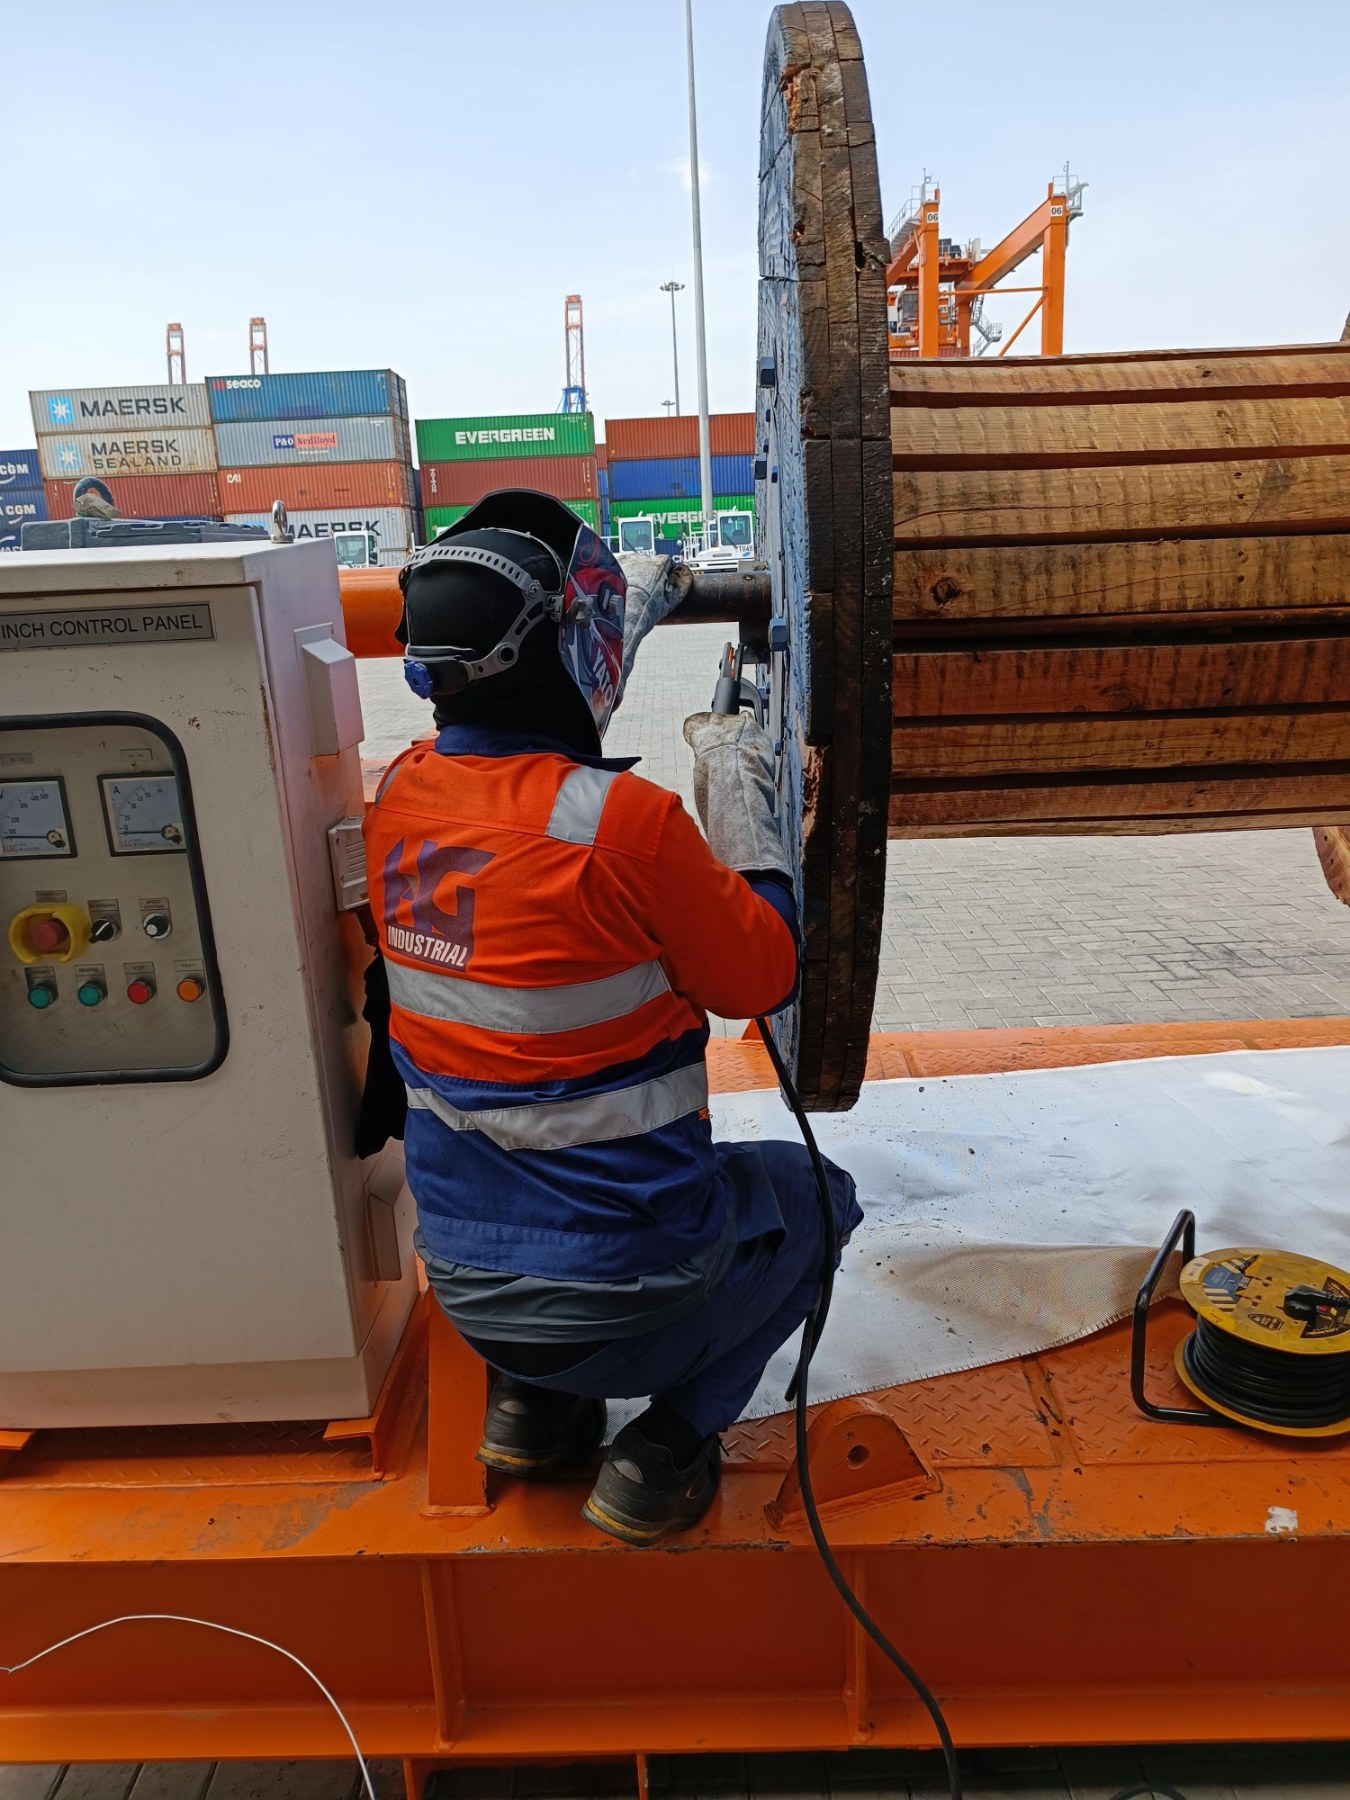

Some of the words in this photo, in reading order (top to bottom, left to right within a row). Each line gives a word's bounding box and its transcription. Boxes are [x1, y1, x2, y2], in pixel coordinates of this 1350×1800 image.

[927, 213, 939, 221] 06
[1051, 207, 1062, 215] 06
[226, 379, 261, 389] seaco
[80, 397, 187, 417] MAERSK
[275, 438, 294, 447] P&O
[296, 434, 336, 446] Nedlloyd
[454, 427, 555, 445] EVERGREEN
[91, 439, 179, 456] MAERSK
[93, 455, 182, 469] SEALAND
[226, 474, 242, 484] CAI
[5, 504, 37, 516] CGM
[1, 622, 45, 639] INCH
[50, 617, 139, 637] CONTROL
[142, 613, 203, 632] PANEL
[113, 785, 120, 795] A
[388, 925, 468, 967] INDUSTRIAL
